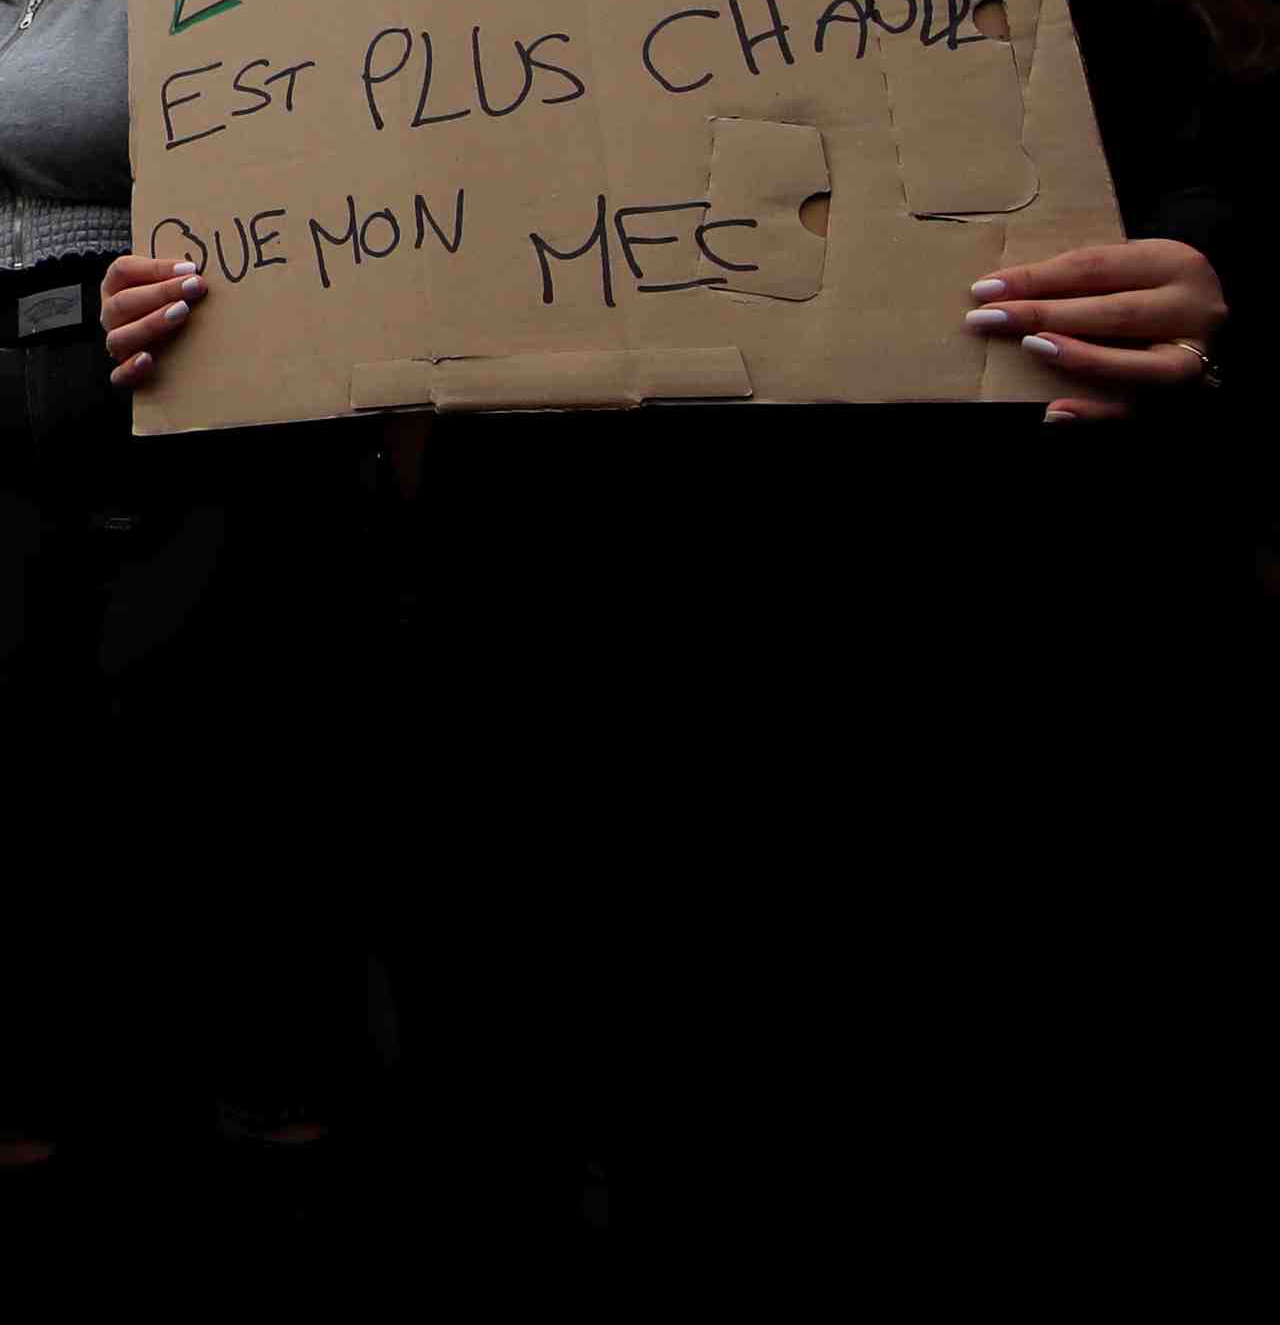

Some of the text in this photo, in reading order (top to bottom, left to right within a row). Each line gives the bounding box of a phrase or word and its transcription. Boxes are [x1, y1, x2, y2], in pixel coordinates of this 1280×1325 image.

[160, 59, 316, 152] EST
[361, 25, 587, 132] PLUS
[308, 189, 465, 288] MON
[529, 194, 759, 308] MEC
